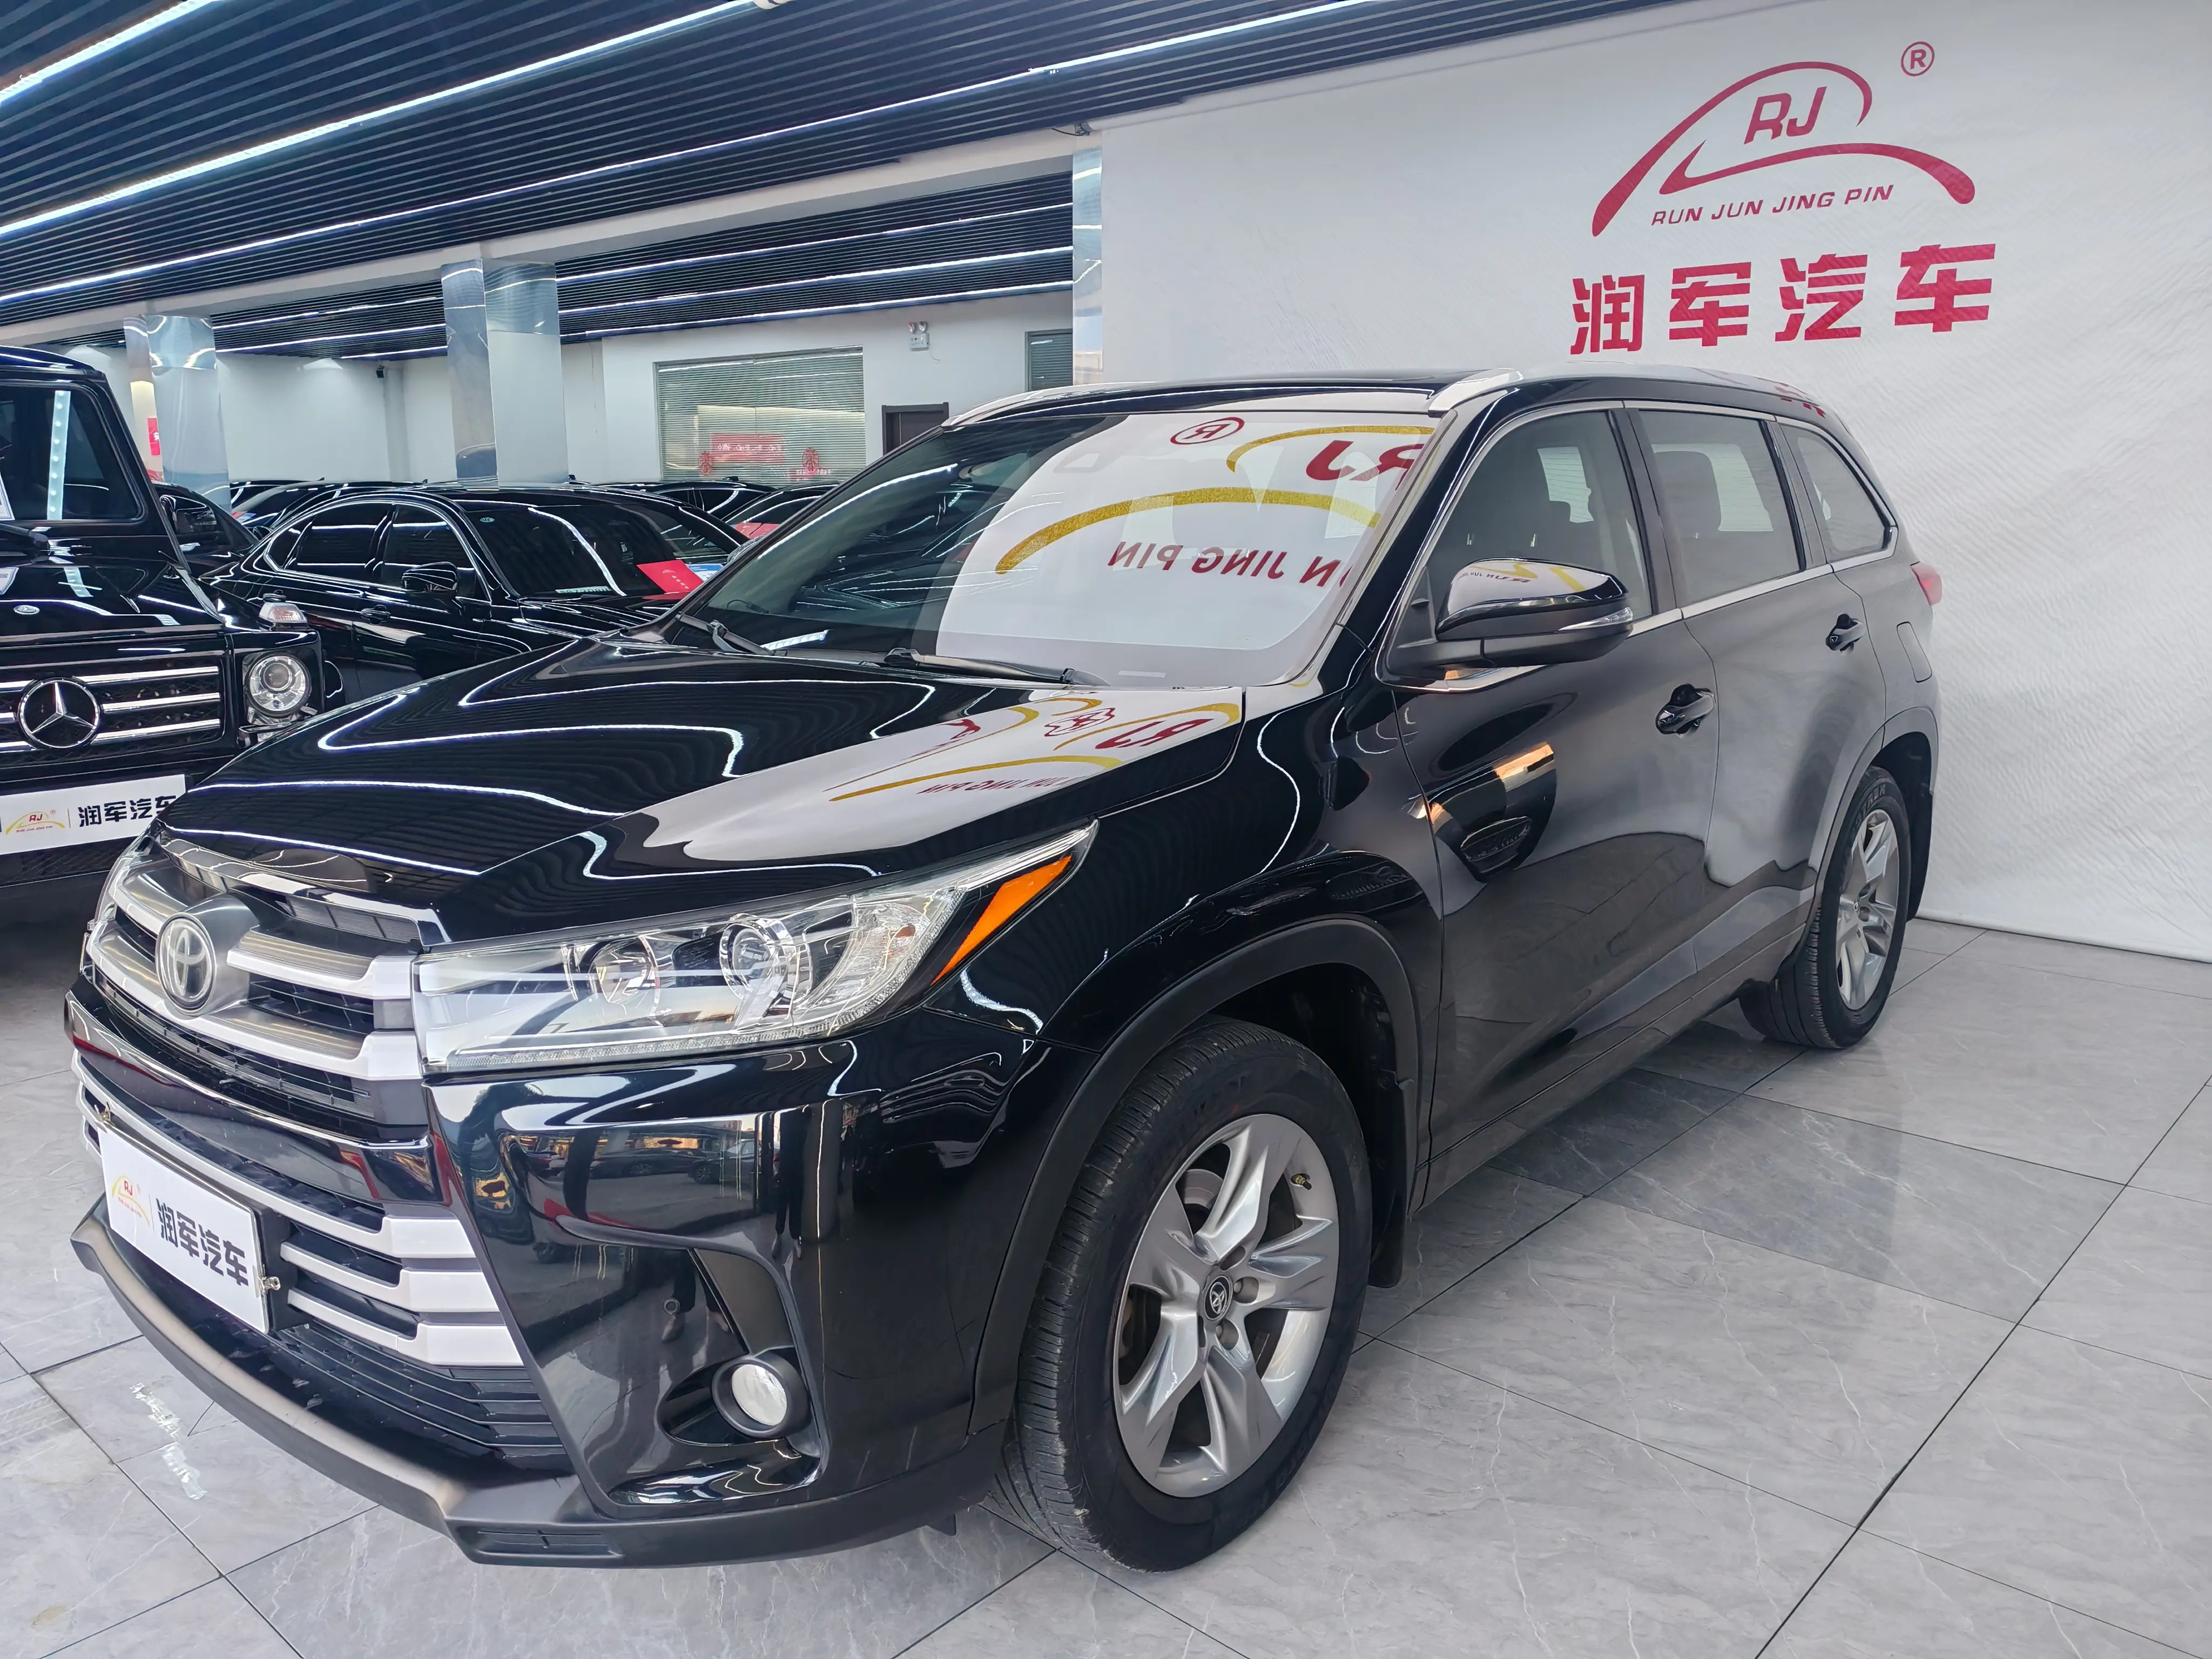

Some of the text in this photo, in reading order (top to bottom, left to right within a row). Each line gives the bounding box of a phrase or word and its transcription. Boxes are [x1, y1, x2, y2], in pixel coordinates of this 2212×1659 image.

[1744, 86, 1827, 144] RJ
[1651, 185, 1893, 226] RUN JUN JING PIN
[1569, 243, 1996, 355] 润军汽车
[29, 814, 43, 822] RJ
[124, 1180, 133, 1196] RJ
[156, 1198, 249, 1286] 润军汽车
